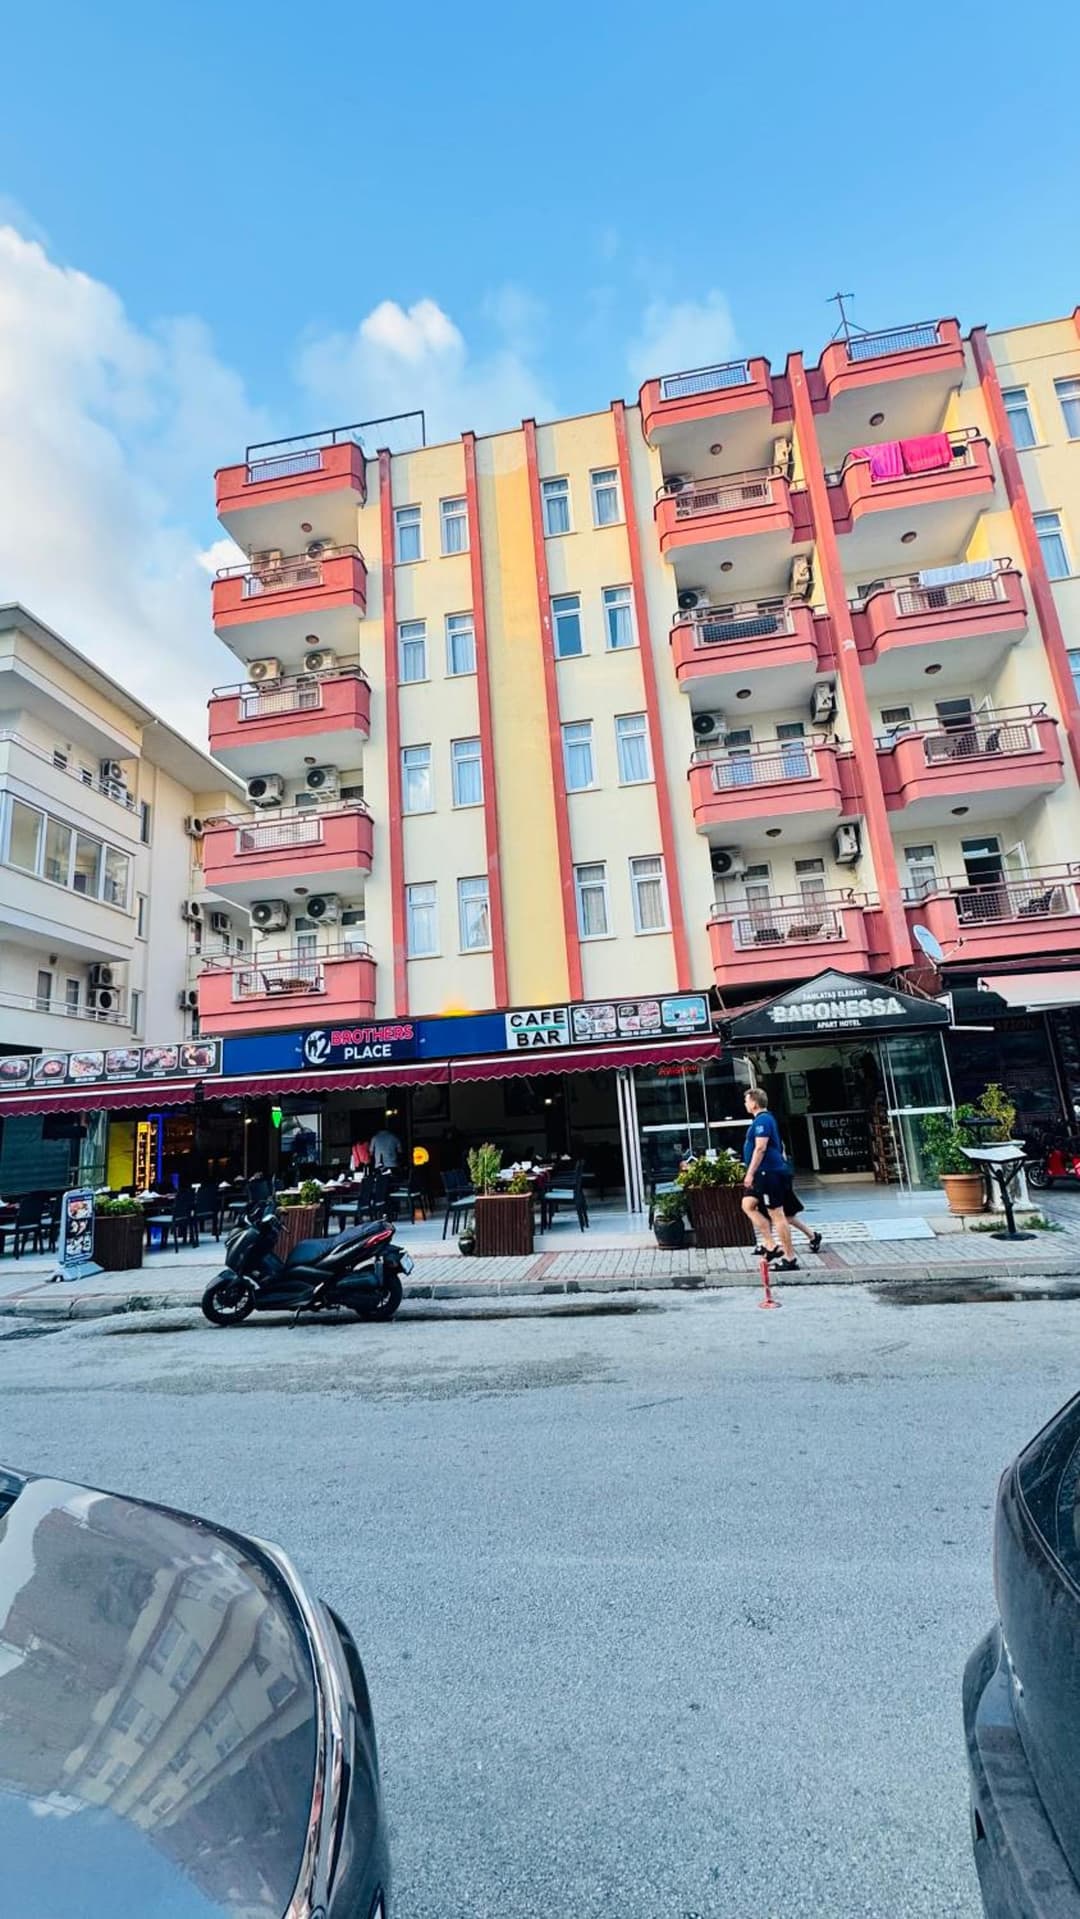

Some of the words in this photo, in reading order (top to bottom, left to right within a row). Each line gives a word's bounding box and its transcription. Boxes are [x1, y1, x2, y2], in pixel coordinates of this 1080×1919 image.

[768, 996, 907, 1023] BARONESSA
[510, 1010, 565, 1028] CAFE
[816, 1020, 838, 1030] APART
[839, 1019, 862, 1029] HOTEL
[331, 1024, 414, 1046] BROTHERS
[517, 1030, 561, 1047] BAR
[344, 1044, 393, 1060] PLACE
